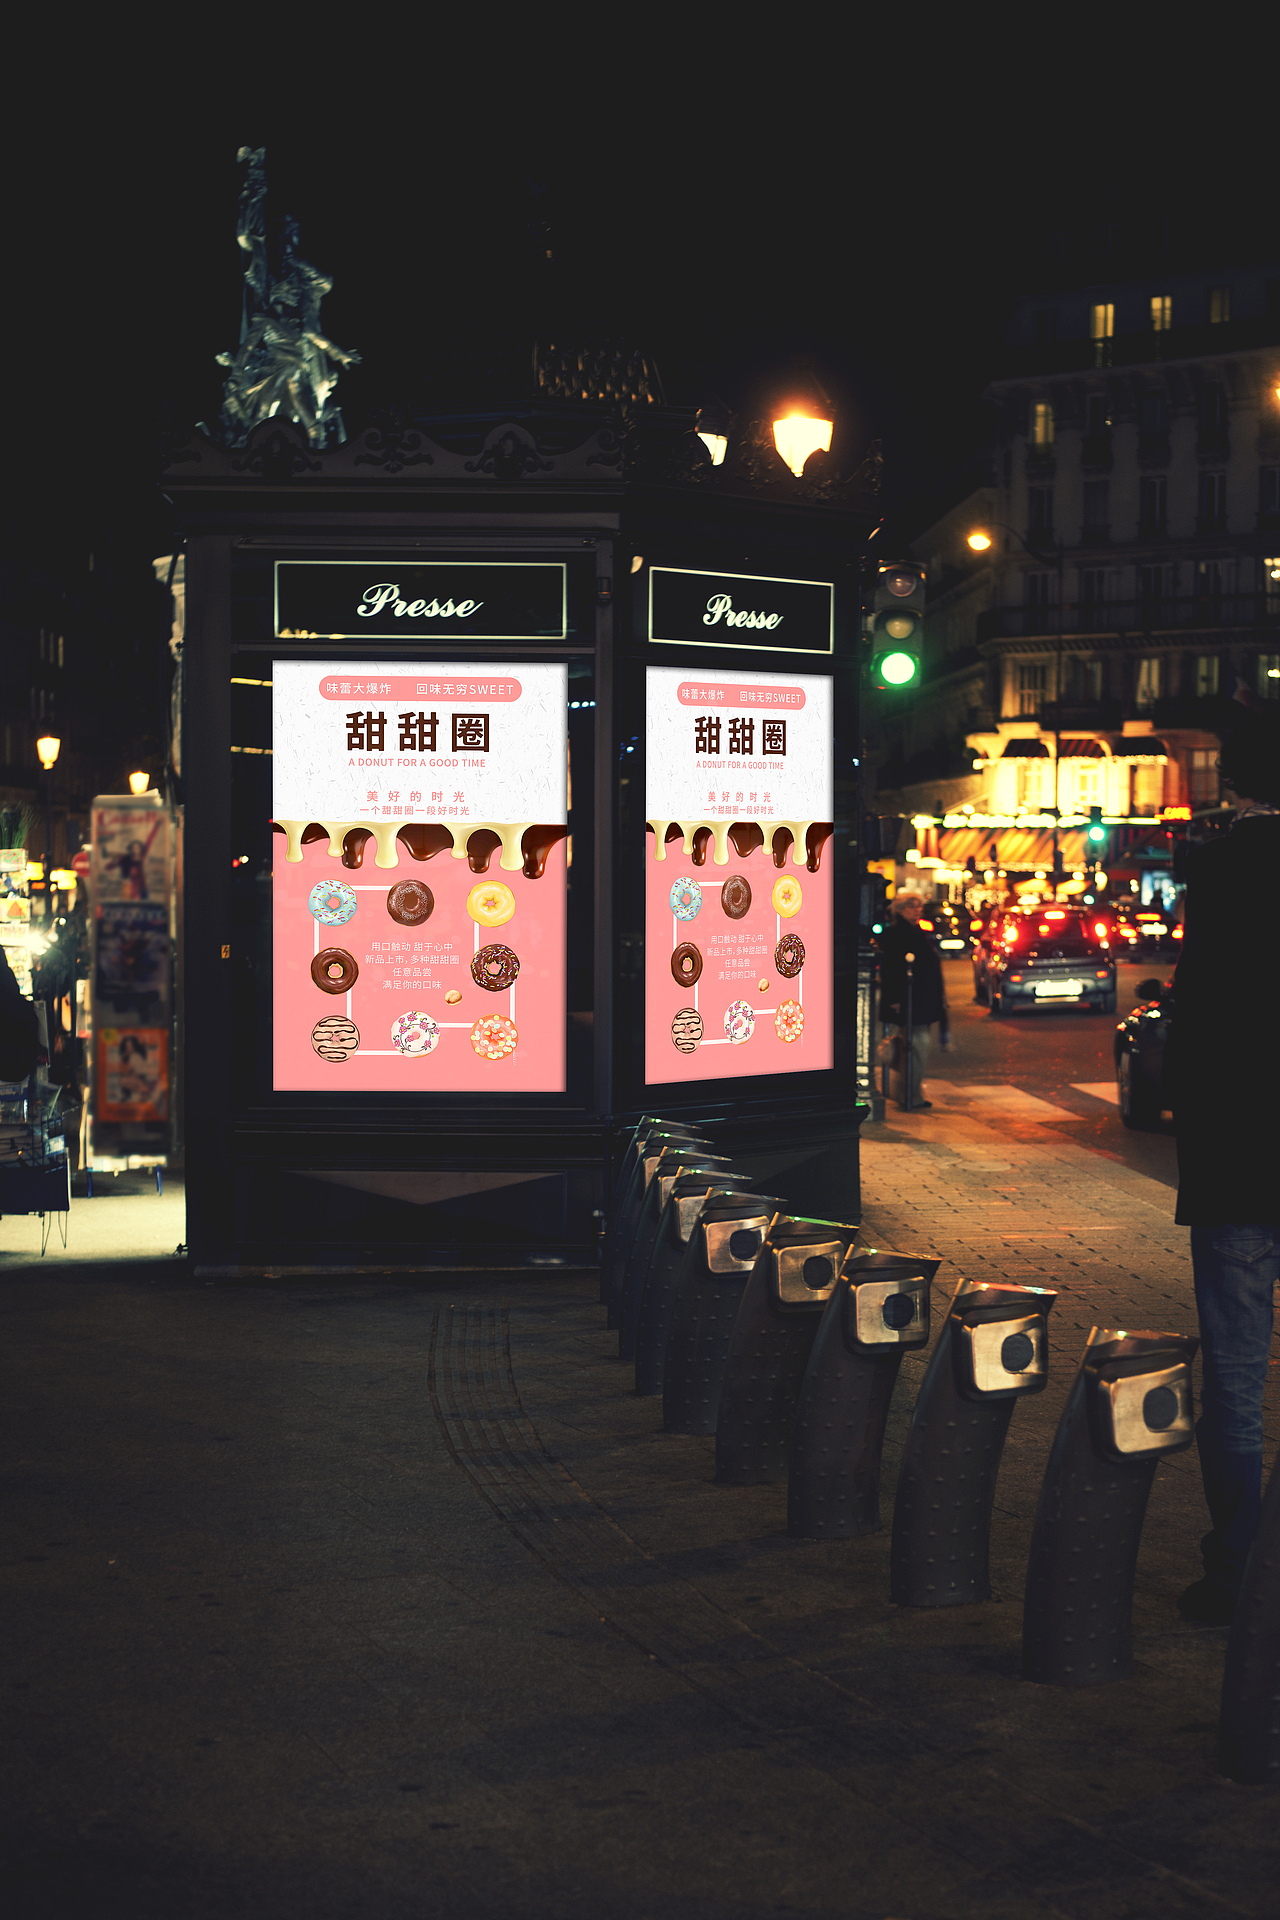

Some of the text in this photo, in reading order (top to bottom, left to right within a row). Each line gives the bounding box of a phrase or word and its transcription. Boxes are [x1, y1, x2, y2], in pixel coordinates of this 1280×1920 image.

[357, 584, 483, 617] Presse
[703, 594, 783, 629] Presse
[327, 682, 514, 695] 味蕾大爆炸 回味无穷SWEET
[682, 689, 801, 703] 味蕾大爆炸 回味无穷SWEET
[346, 711, 489, 752] 甜甜圈
[695, 716, 786, 756] 甜甜圈
[349, 758, 355, 766] A
[358, 758, 394, 766] DONUT
[398, 759, 417, 767] FOR
[429, 759, 458, 767] GOOD
[462, 759, 485, 767] TIME
[360, 804, 469, 815] 一个甜甜圈一段好时光
[704, 804, 773, 814] 一个甜甜圈一段好时光
[371, 942, 452, 951] 用口触动 甜于心中
[393, 968, 431, 976] 任意品尝
[383, 980, 441, 989] 满足你的口味
